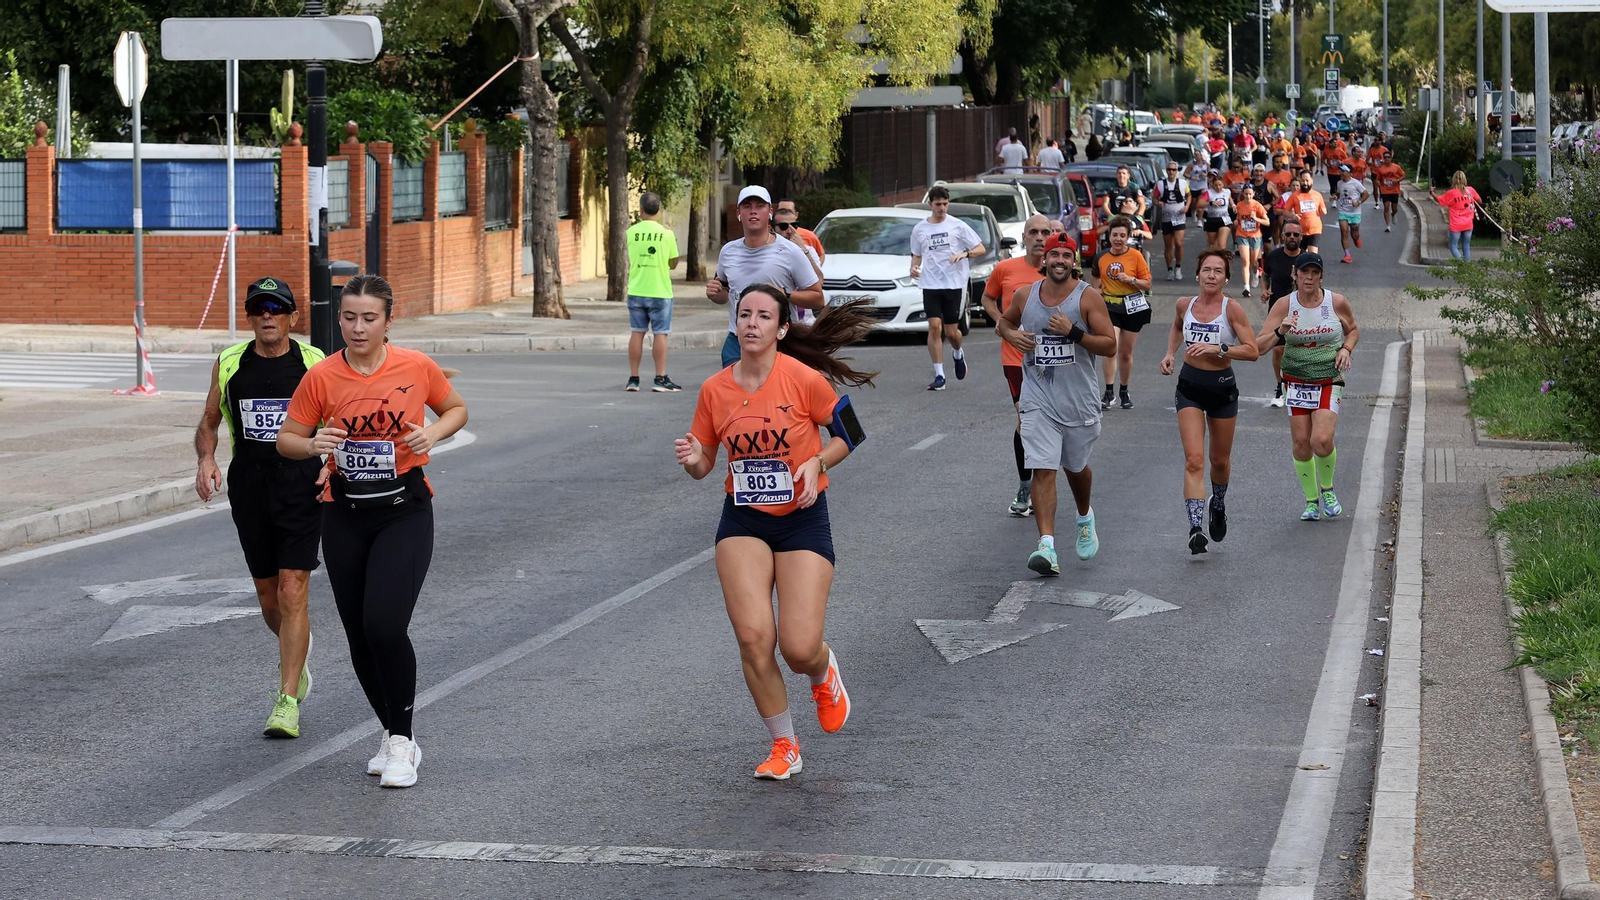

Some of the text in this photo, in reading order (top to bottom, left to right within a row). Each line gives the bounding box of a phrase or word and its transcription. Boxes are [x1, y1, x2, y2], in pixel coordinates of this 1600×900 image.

[634, 232, 664, 241] STAFF
[1131, 299, 1144, 307] 627
[1191, 332, 1211, 343] 776
[1043, 346, 1063, 357] 911
[1295, 390, 1313, 400] 601
[345, 454, 379, 468] 804
[746, 474, 777, 490] 803
